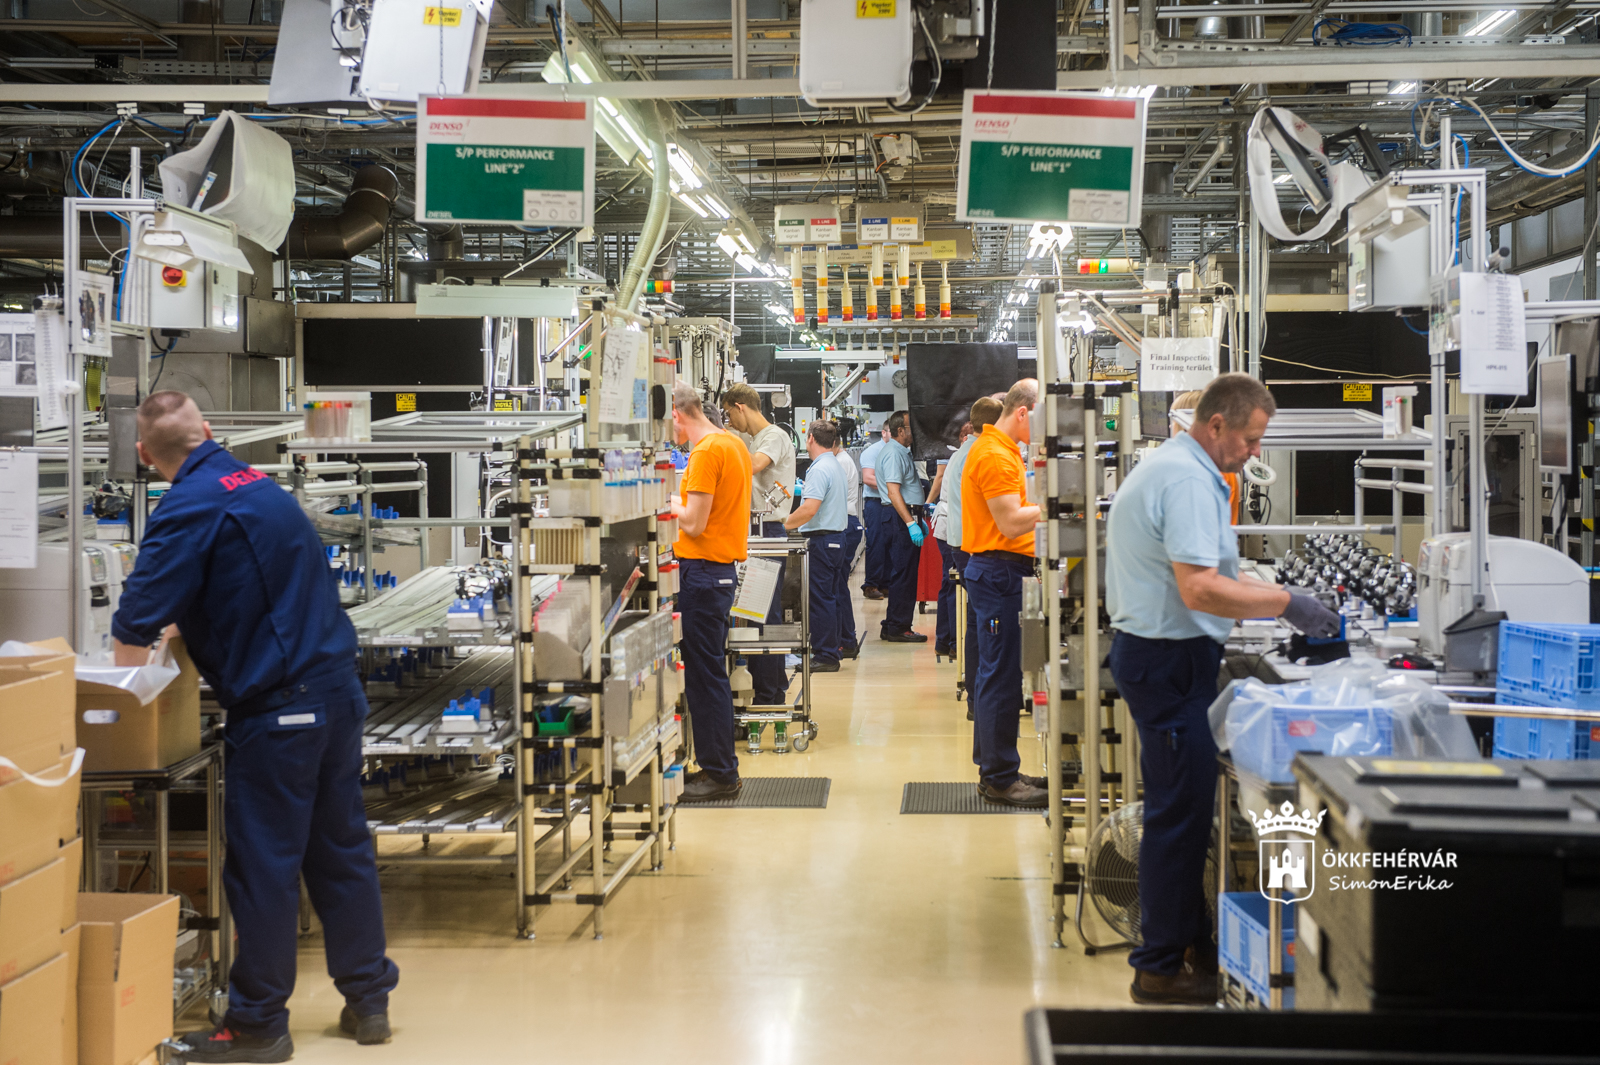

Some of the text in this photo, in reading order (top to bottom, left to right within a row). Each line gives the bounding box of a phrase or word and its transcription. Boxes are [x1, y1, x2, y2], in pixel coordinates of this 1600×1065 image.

[429, 121, 464, 131] DENSO
[975, 119, 1010, 129] DENSO
[455, 147, 555, 161] S/P PERFORMANCE
[1001, 144, 1103, 160] S/P PERFORMANCE
[1150, 353, 1170, 361] Final
[1150, 363, 1184, 372] Training
